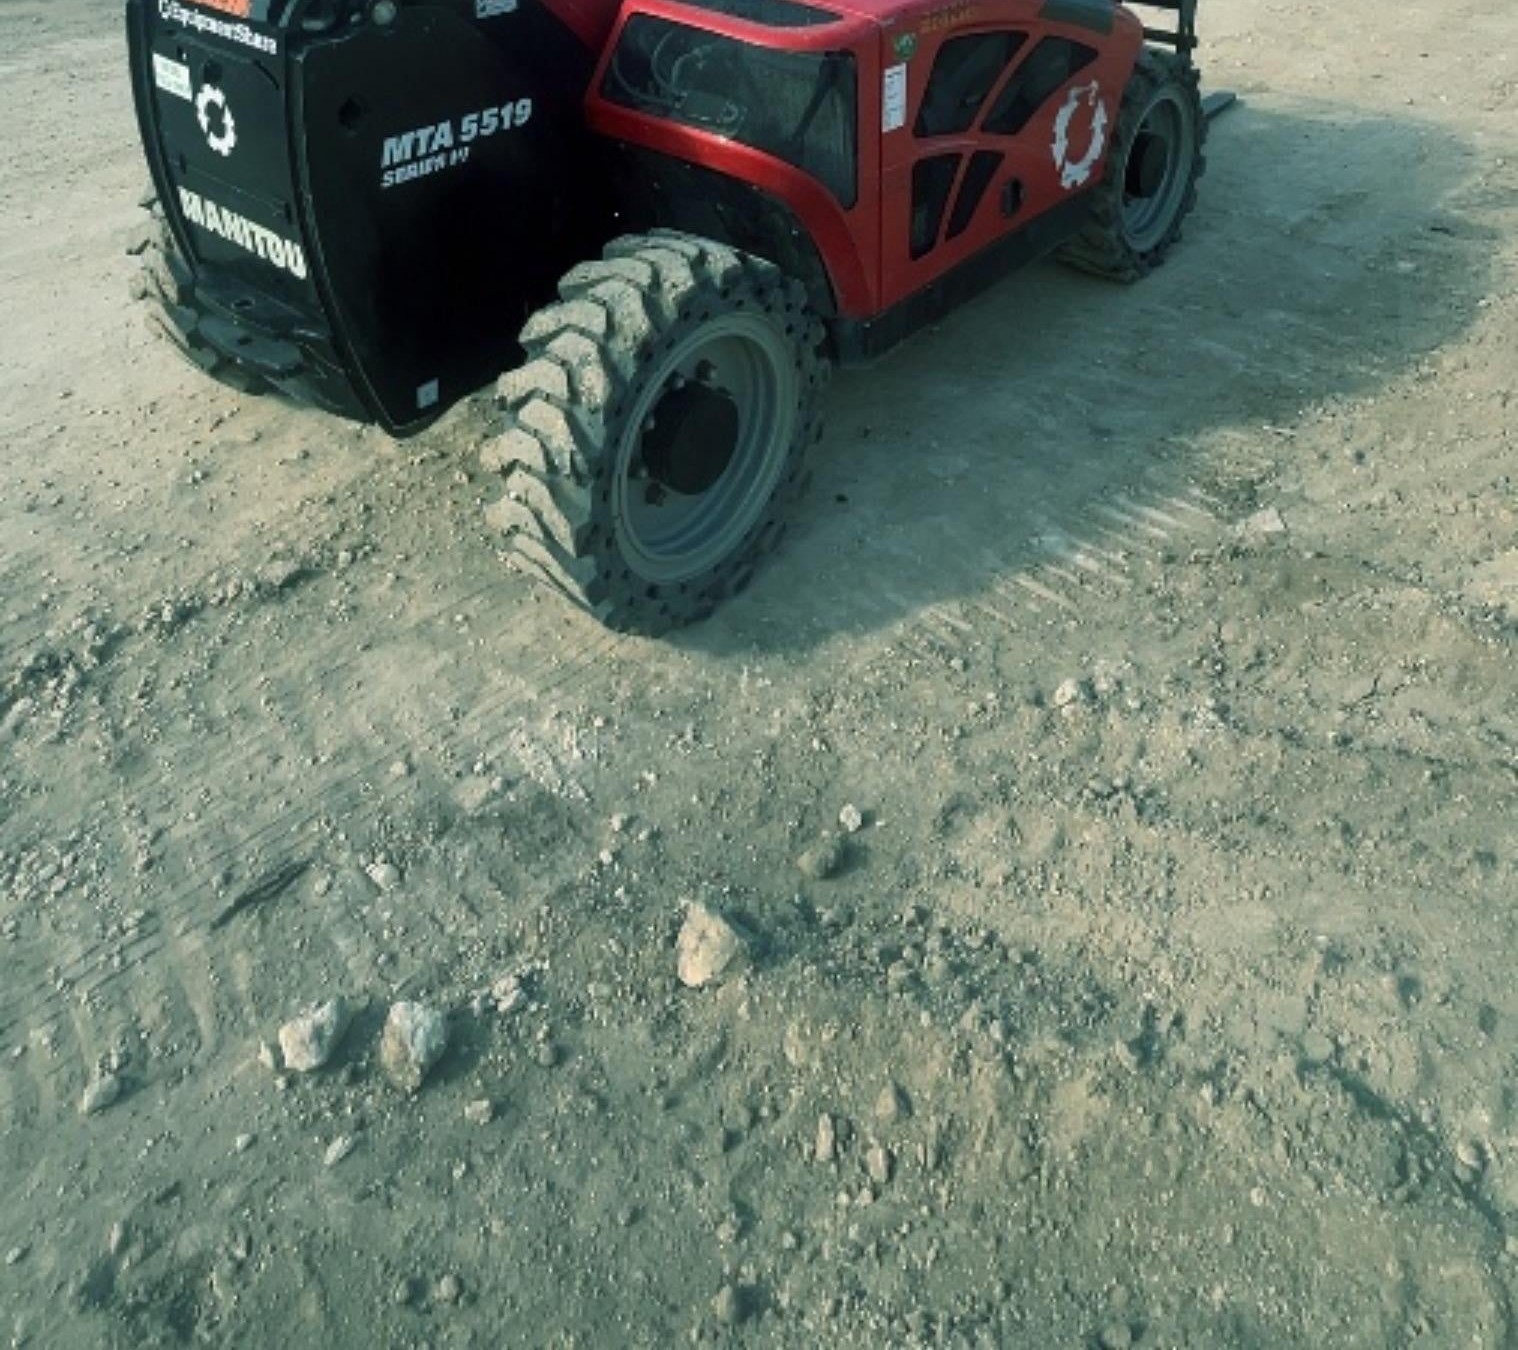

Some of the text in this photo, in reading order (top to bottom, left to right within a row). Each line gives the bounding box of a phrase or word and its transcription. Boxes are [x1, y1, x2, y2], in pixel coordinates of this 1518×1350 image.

[381, 97, 533, 169] MTA 5519
[177, 185, 307, 280] MANITOU
